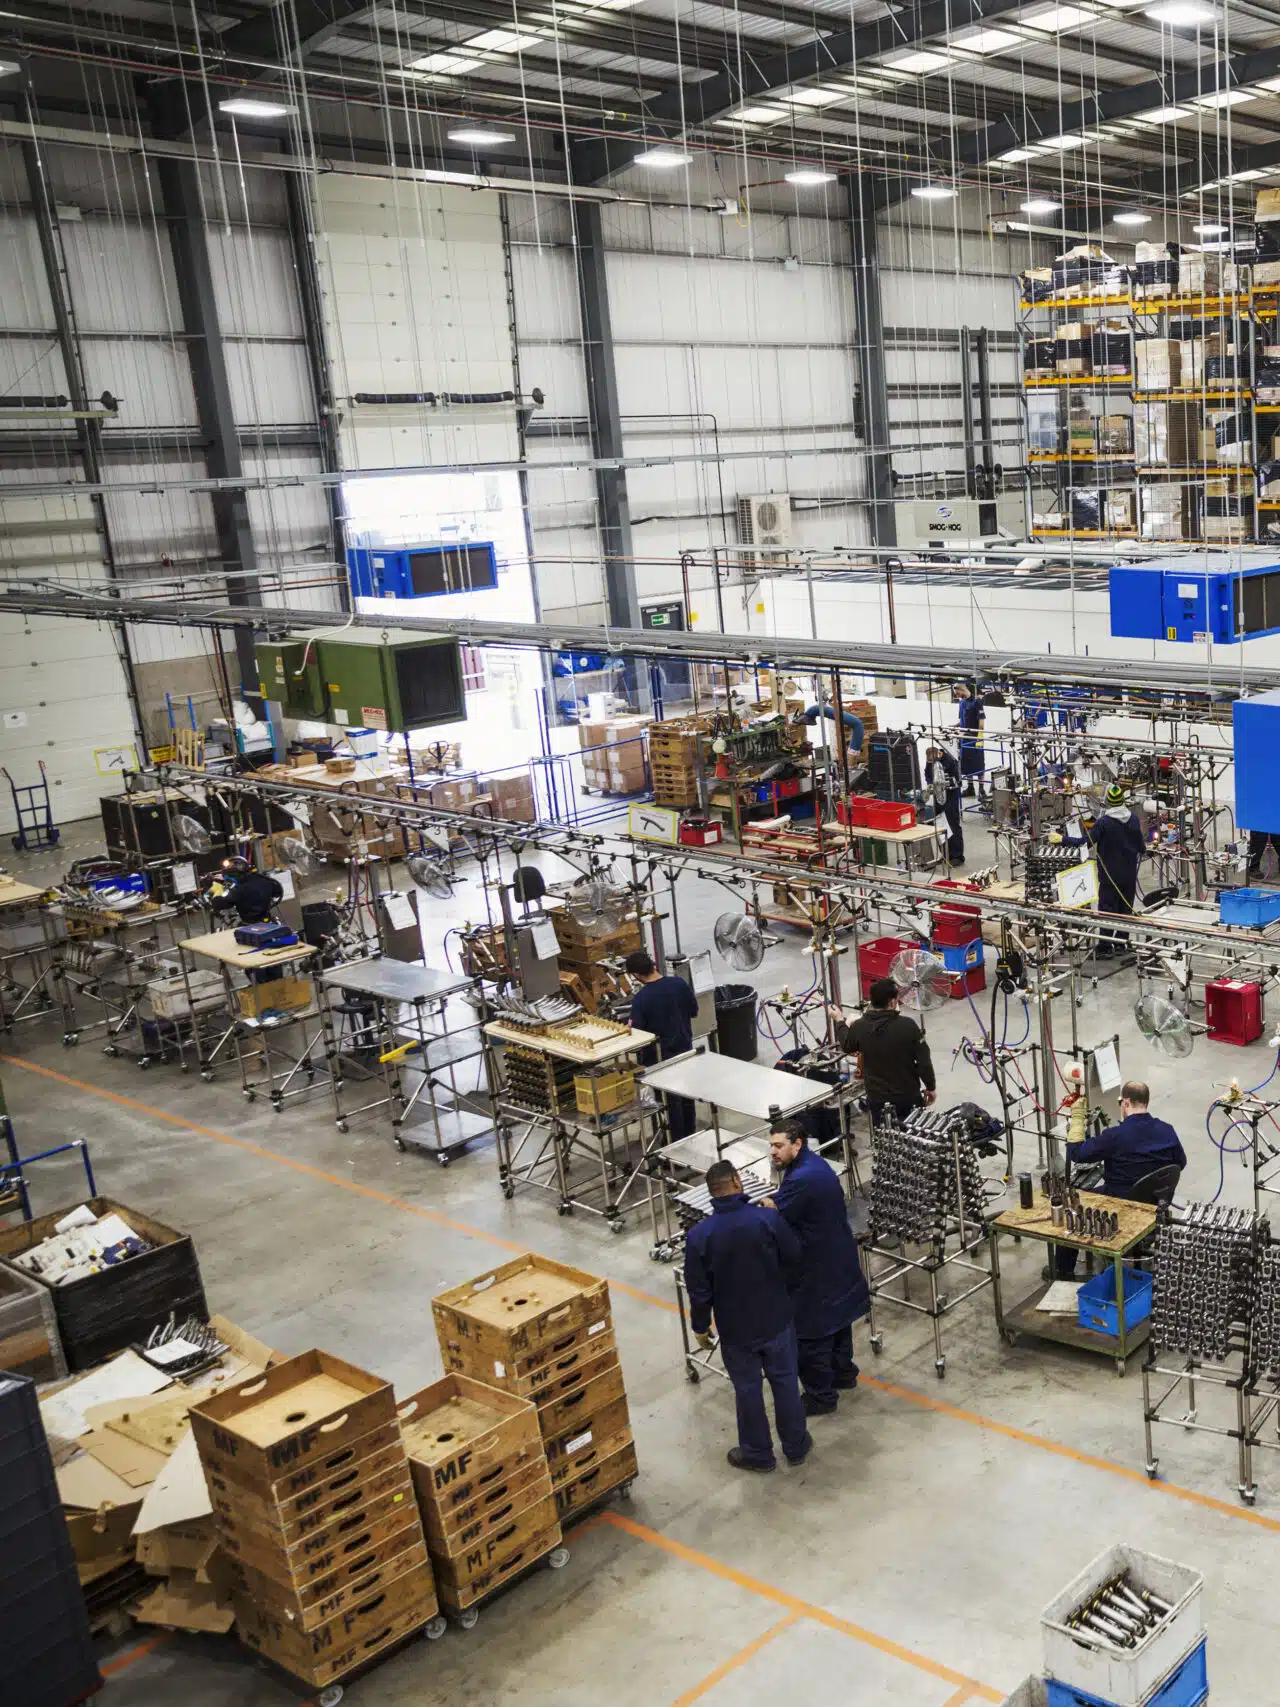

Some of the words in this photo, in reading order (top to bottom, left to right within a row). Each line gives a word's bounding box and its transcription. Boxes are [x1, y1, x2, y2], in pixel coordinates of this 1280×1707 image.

[530, 1367, 551, 1386] MF
[271, 1424, 317, 1468] MF
[434, 1450, 473, 1490] MF
[456, 1504, 478, 1524] MF
[305, 1533, 330, 1554] MF
[462, 1521, 484, 1544] MF
[308, 1551, 336, 1575] MF
[320, 1591, 346, 1617] MF
[332, 1647, 357, 1673] MF
